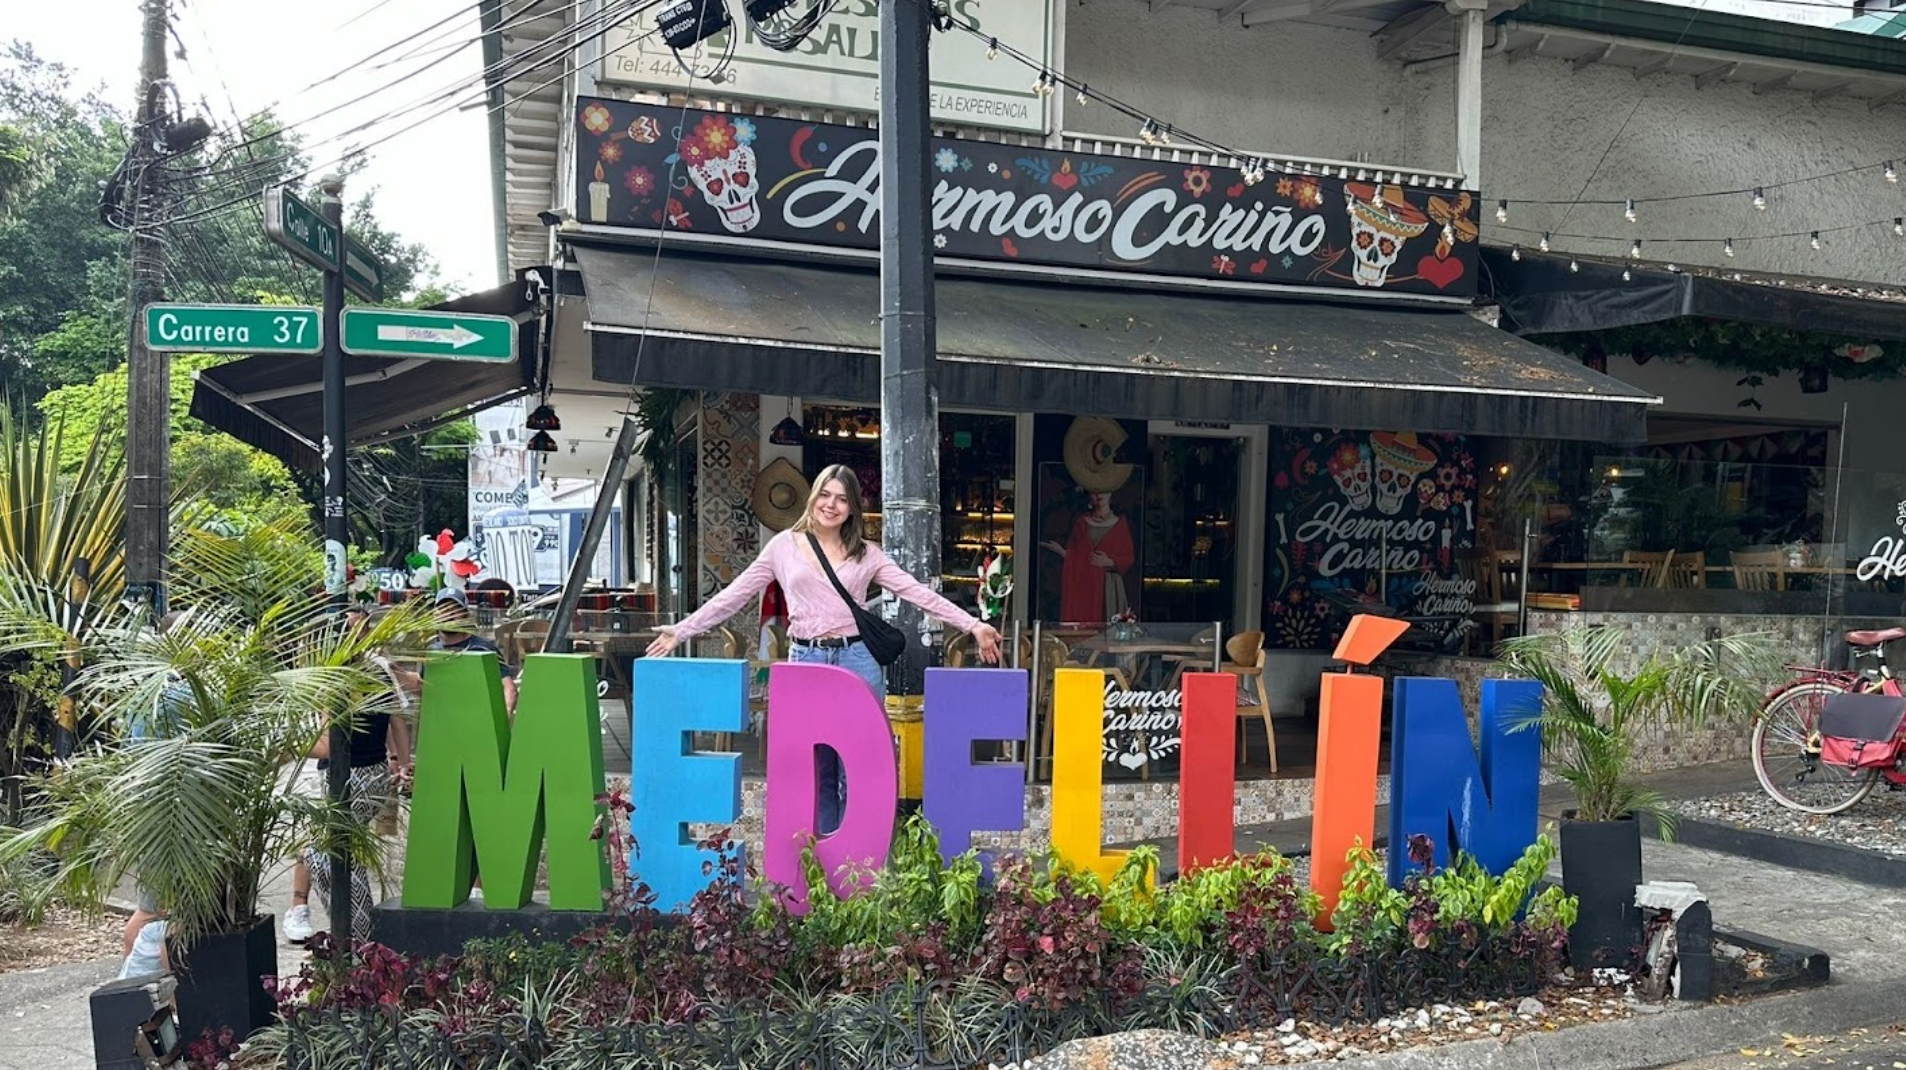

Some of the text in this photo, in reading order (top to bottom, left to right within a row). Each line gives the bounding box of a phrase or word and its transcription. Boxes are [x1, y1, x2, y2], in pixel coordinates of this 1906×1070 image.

[615, 55, 644, 73] Tel:
[650, 60, 682, 77] 444
[939, 96, 953, 110] LA
[955, 97, 1028, 119] EXPERIENCIA
[782, 140, 1327, 262] Hrmoso Cariño
[286, 201, 335, 260] Calle 10A
[157, 312, 309, 344] Carrera 37
[1295, 501, 1436, 543] Hermoso
[1318, 541, 1421, 577] Cariño
[1412, 569, 1477, 596] Hermoso
[1421, 594, 1470, 616] Cariño
[400, 614, 1543, 933] MEDELLÍN
